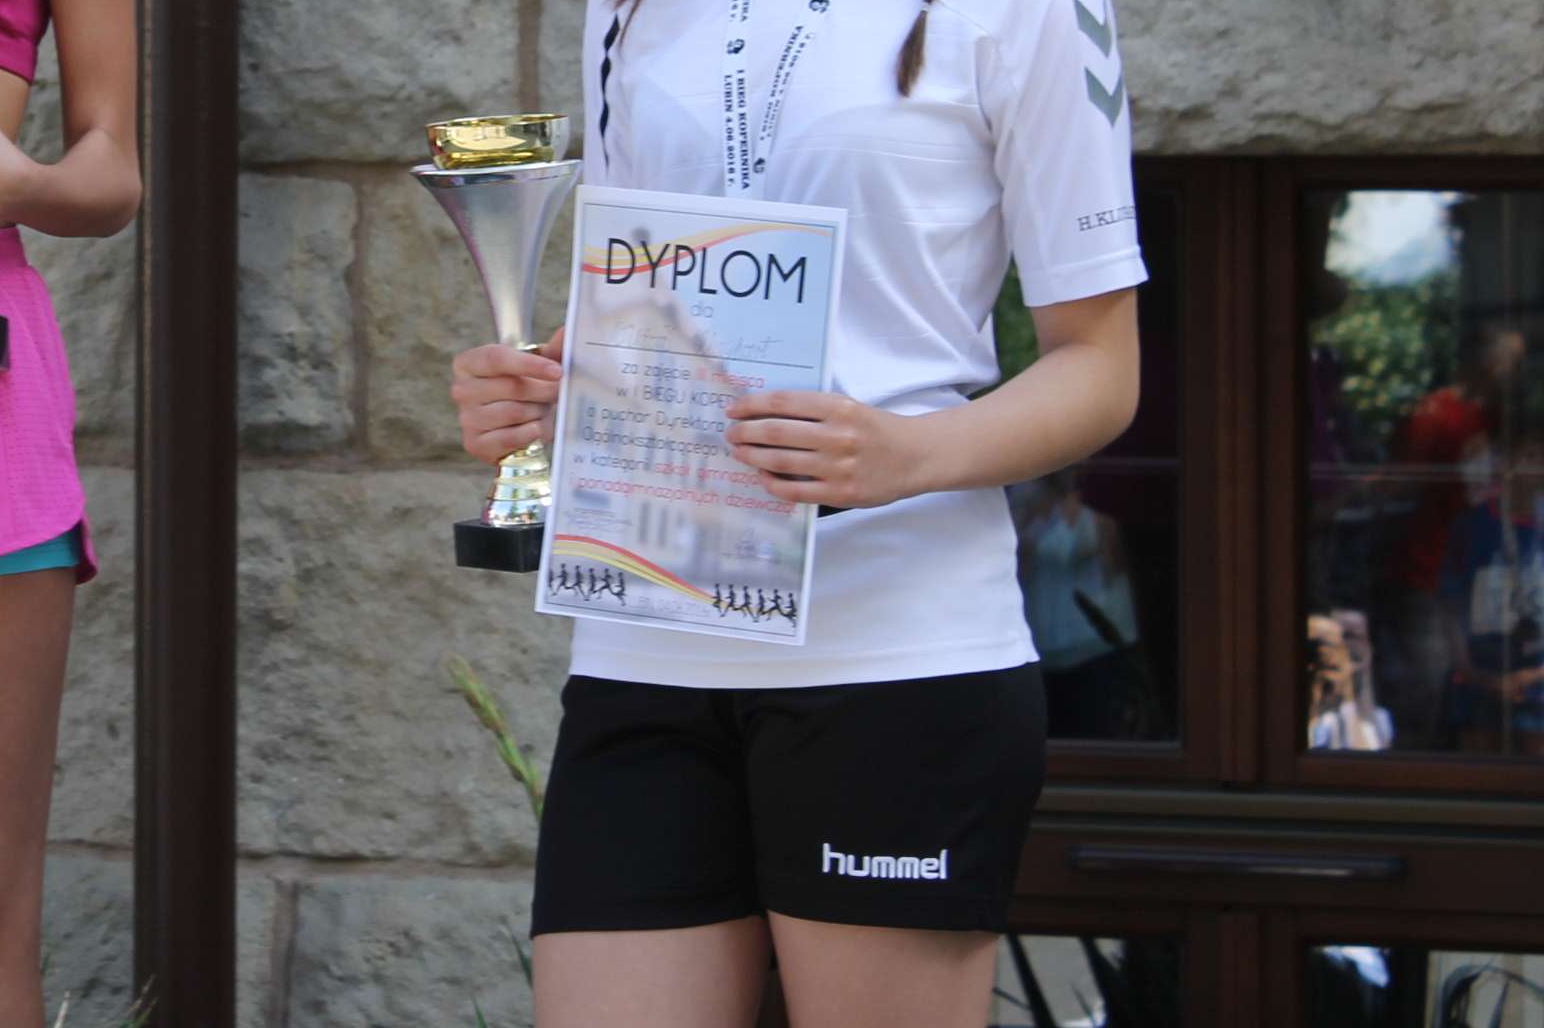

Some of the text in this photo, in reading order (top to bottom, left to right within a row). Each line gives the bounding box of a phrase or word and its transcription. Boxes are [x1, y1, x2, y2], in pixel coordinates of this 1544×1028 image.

[723, 74, 733, 112] LUBIN
[738, 112, 751, 190] KOPERNIKA
[606, 238, 807, 303] DYPLOM
[642, 384, 684, 404] BIEGU
[656, 410, 725, 433] Dyrektora
[821, 842, 948, 880] hummel
